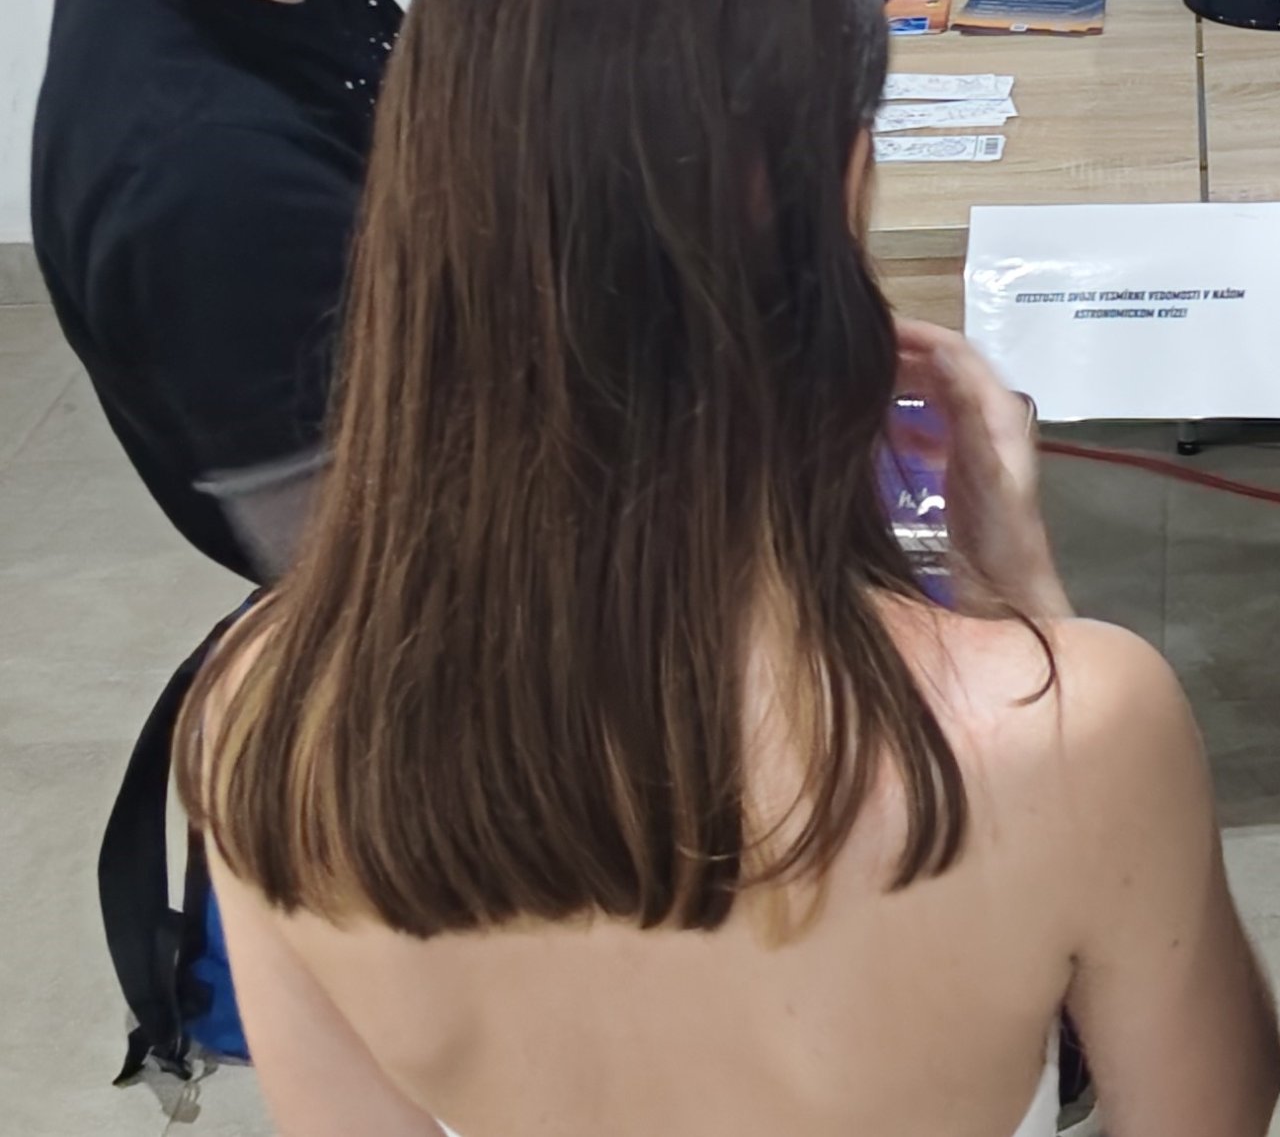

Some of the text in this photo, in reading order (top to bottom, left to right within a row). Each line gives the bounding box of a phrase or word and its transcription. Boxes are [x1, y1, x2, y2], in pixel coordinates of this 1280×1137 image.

[1015, 287, 1246, 304] OTESTUJTE SVOJE VESMÍRNE VEDOMOSTI V NAŠOM
[1073, 308, 1155, 319] ASTRONOMICKOM
